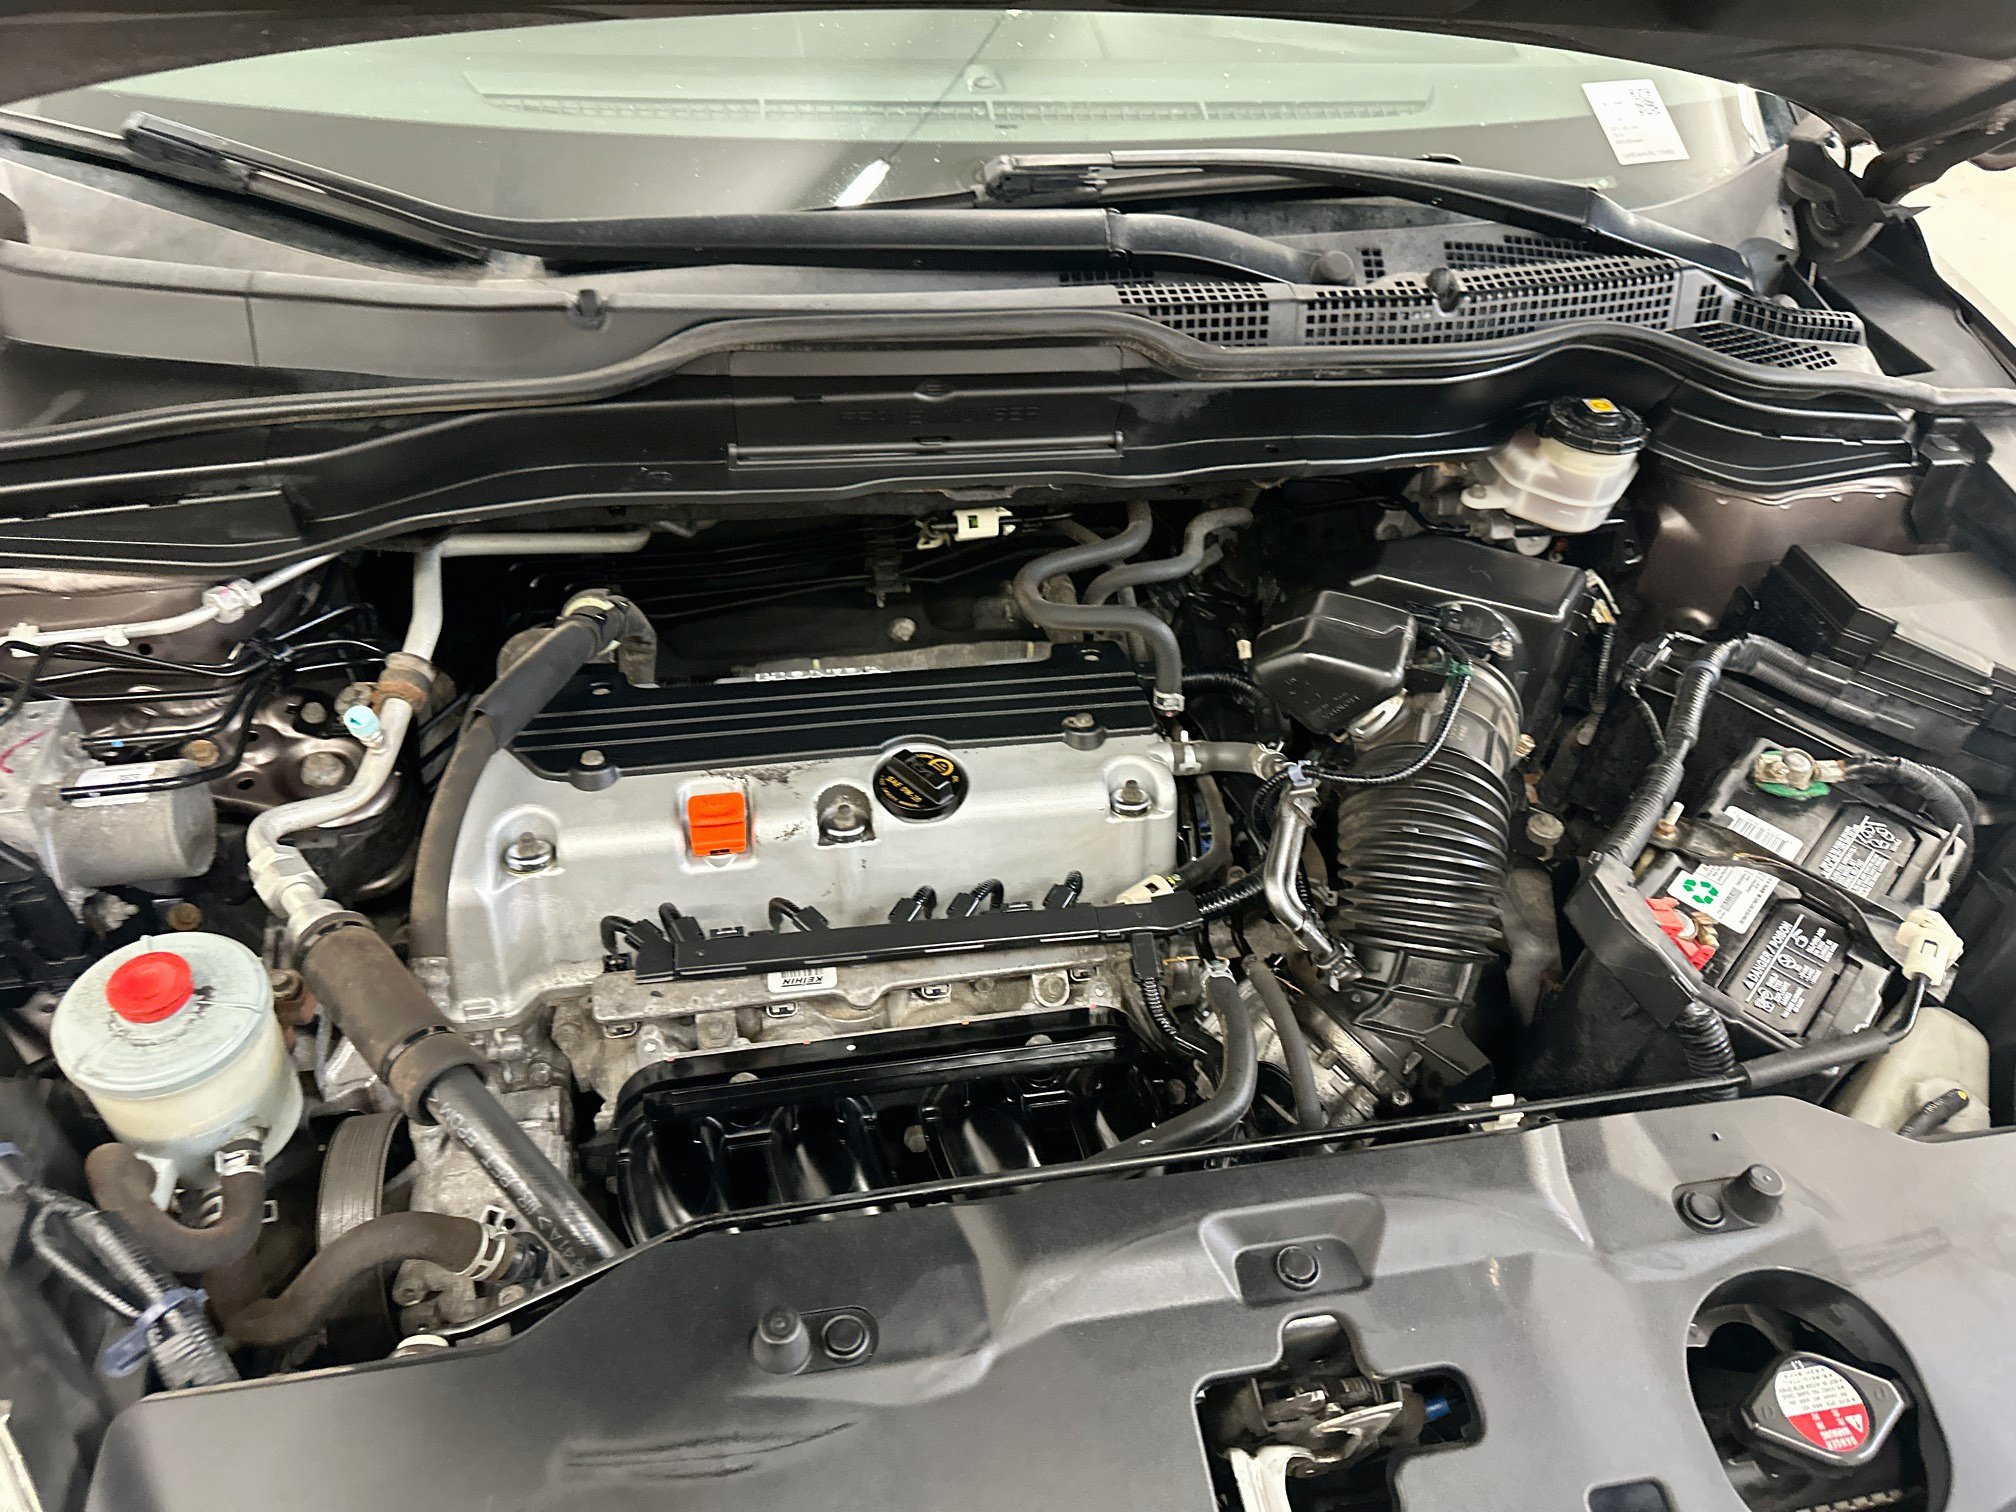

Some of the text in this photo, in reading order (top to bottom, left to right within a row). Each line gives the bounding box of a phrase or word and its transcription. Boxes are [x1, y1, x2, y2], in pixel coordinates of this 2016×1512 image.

[1747, 951, 1775, 982] DANGER
[1769, 920, 1793, 949] POISON
[782, 976, 823, 985] KEIHIN
[1825, 1434, 1858, 1450] DANGER
